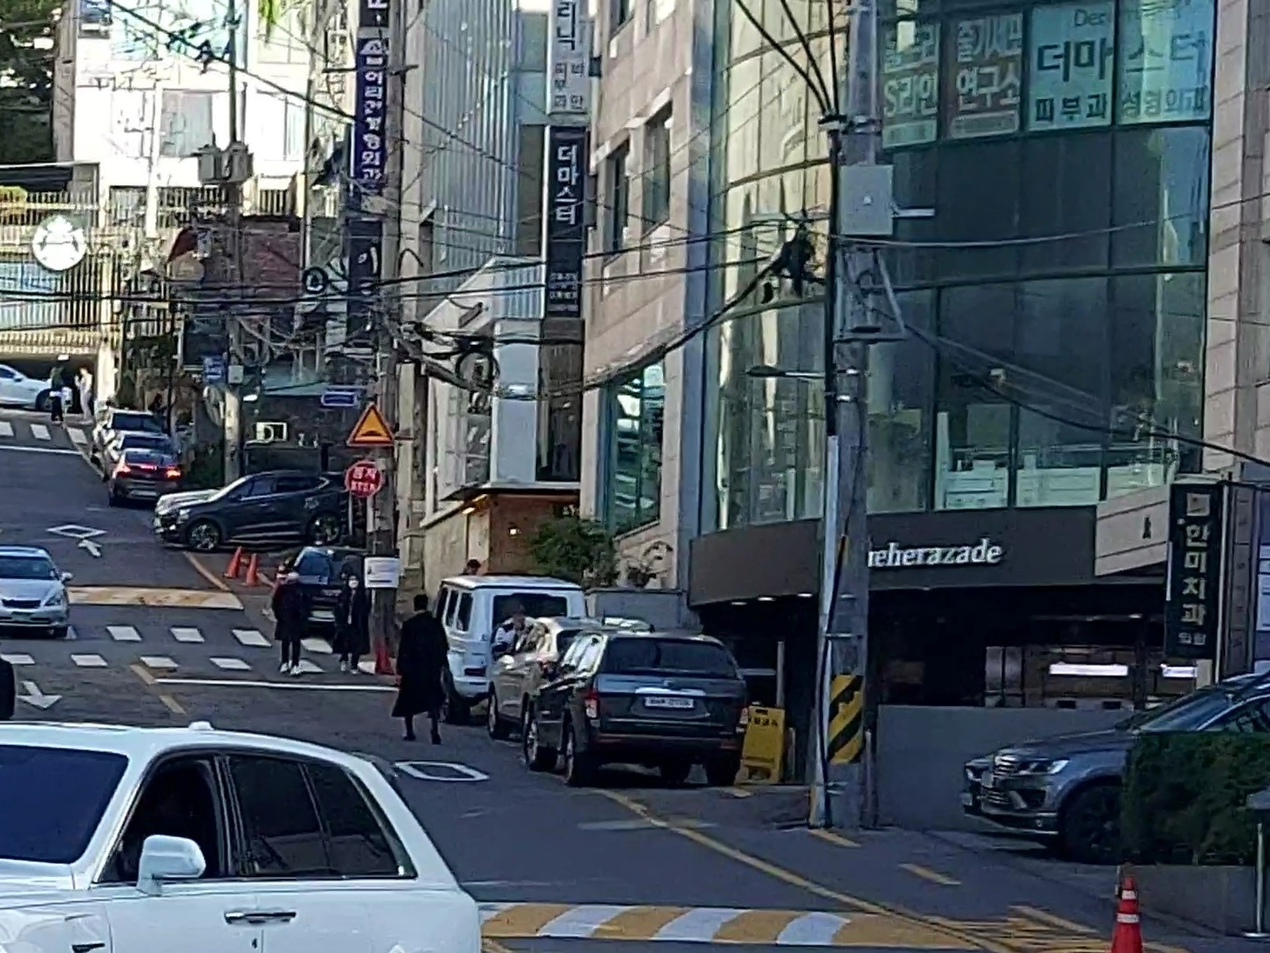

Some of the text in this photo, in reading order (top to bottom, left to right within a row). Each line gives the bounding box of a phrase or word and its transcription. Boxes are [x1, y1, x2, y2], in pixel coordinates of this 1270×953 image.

[884, 70, 938, 118] S라인
[956, 61, 1021, 112] 연구소
[1035, 93, 1107, 122] 피부과
[556, 145, 579, 225] 더마스터
